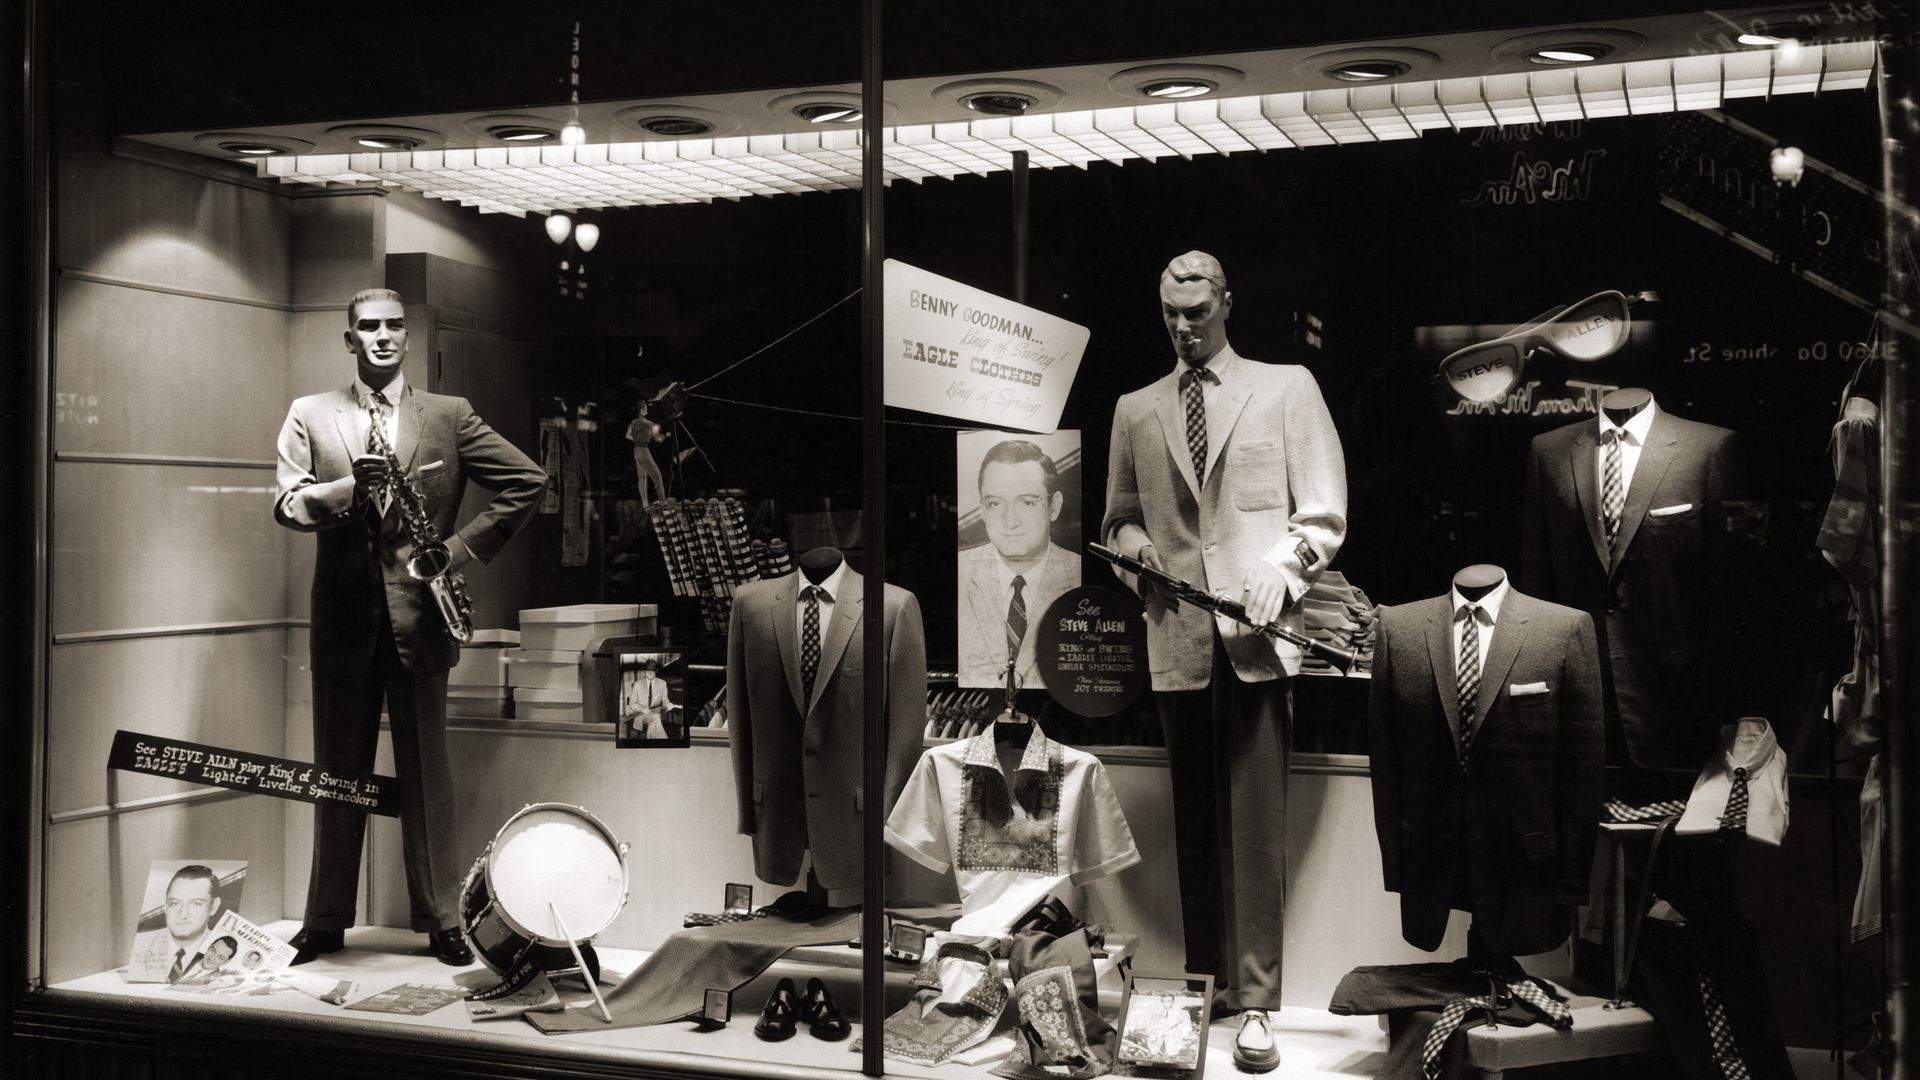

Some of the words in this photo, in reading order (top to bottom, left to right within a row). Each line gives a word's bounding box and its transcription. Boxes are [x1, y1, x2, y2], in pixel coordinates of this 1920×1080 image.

[909, 289, 958, 318] BENNY
[1566, 311, 1617, 341] ALLEN
[902, 338, 959, 369] EAGLE
[970, 356, 1043, 387] CLOTHES
[959, 327, 990, 353] King
[993, 340, 1009, 361] of
[1012, 342, 1069, 371] Swing!
[1455, 357, 1506, 382] STEVE
[945, 380, 971, 402] King
[977, 389, 994, 409] of
[995, 388, 1043, 419] Spring
[1075, 598, 1101, 616] See
[1059, 617, 1088, 632] STEVE
[1094, 619, 1125, 633] ALLEN
[1074, 685, 1090, 693] JOY
[134, 742, 157, 756] See
[162, 746, 204, 764] STEVE
[205, 754, 239, 770] ALLN
[238, 761, 265, 778] play
[268, 764, 296, 783] King
[299, 768, 314, 783] of
[319, 772, 358, 793] Swing
[364, 782, 380, 795] in
[134, 755, 188, 775] EAGLE'S
[201, 766, 250, 786] Lighter
[258, 777, 303, 795] Livelier
[308, 784, 379, 808] Spectacolors
